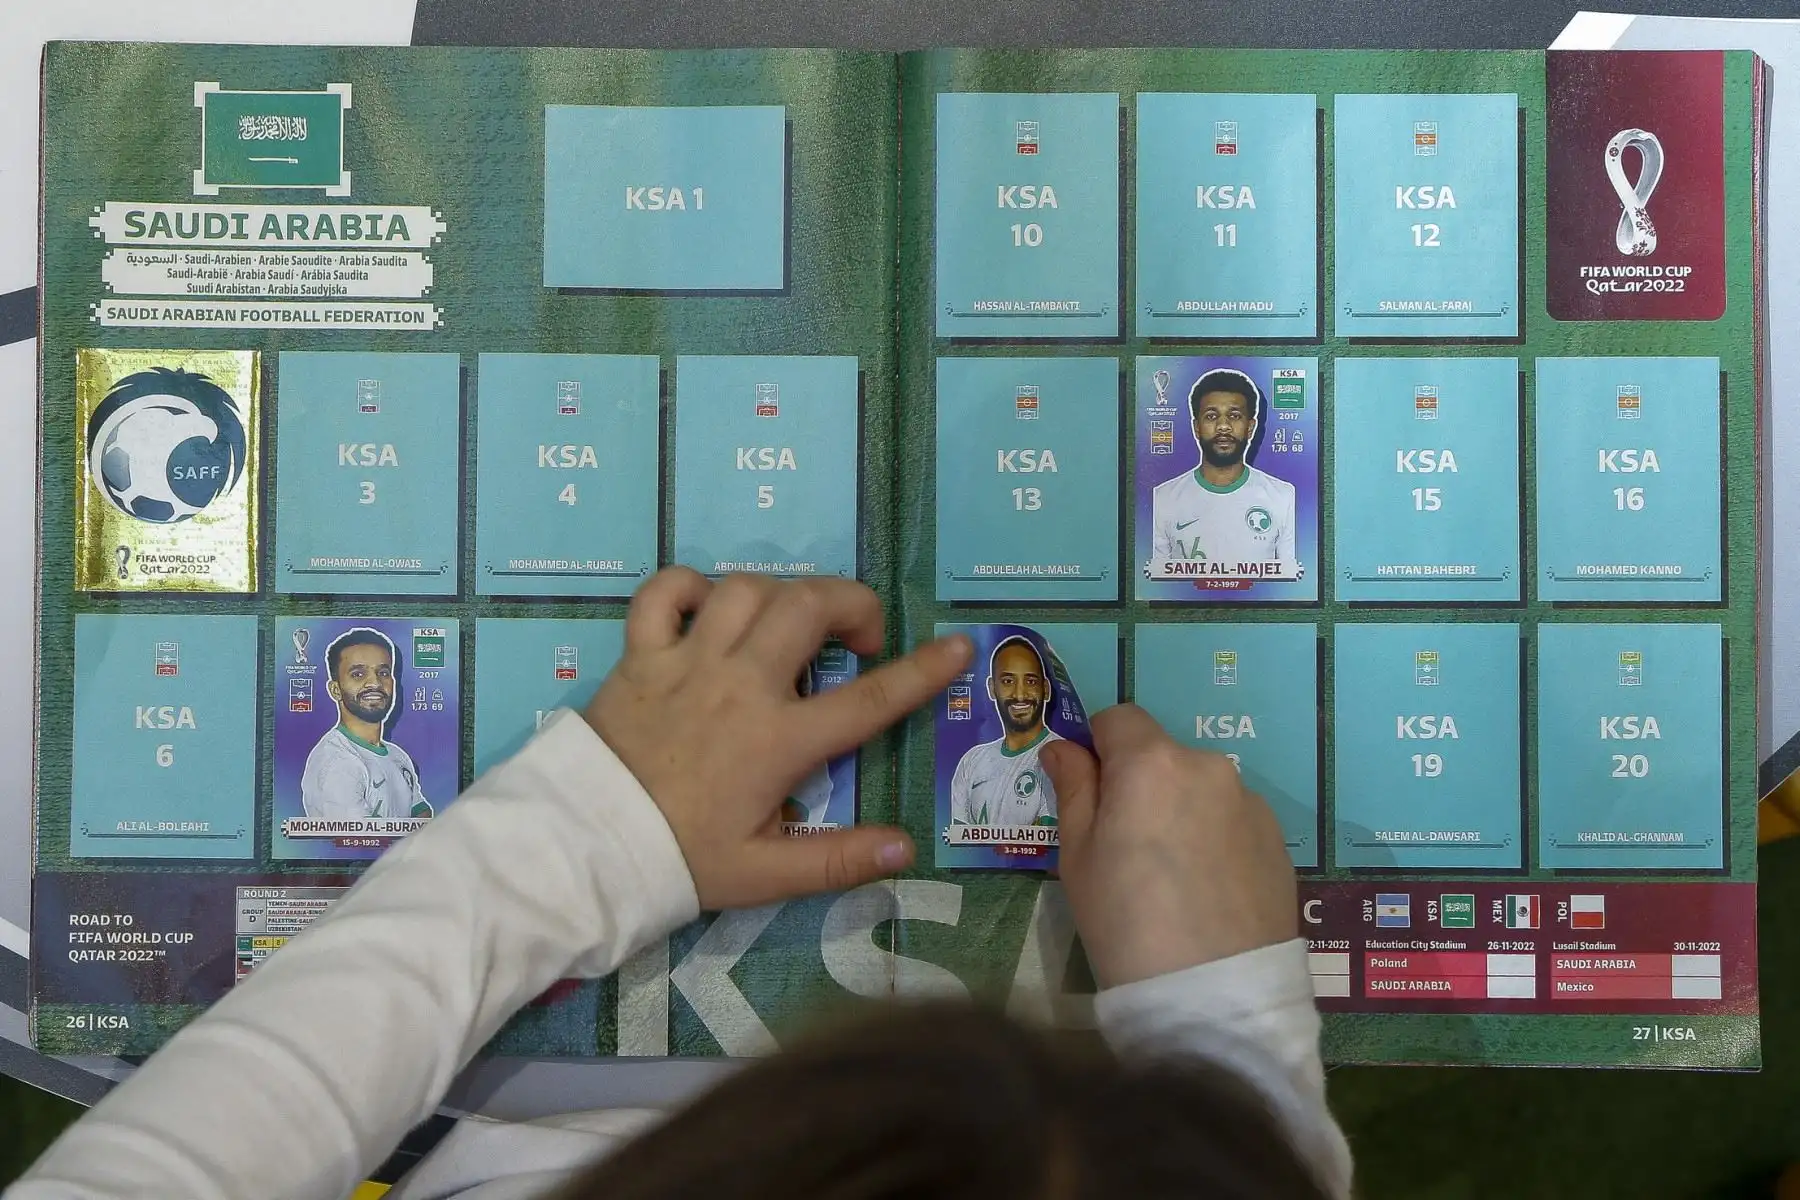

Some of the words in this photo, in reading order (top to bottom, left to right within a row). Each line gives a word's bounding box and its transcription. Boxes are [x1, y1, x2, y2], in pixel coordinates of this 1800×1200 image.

[625, 186, 686, 211] KSA
[693, 186, 703, 210] 1
[998, 185, 1058, 209] KSA
[1196, 185, 1257, 209] KSA
[1395, 185, 1456, 209] KSA
[124, 210, 249, 240] SAUDI
[259, 213, 411, 242] ARABIA
[1010, 223, 1043, 247] 10
[1214, 223, 1237, 247] 11
[1410, 224, 1441, 247] 12
[126, 252, 177, 266] السعودية
[184, 254, 251, 266] Saudi-Arabien
[258, 254, 290, 266] Arabie
[292, 255, 332, 266] Saoudite
[339, 255, 370, 266] Arabia
[372, 256, 408, 267] Saudita
[167, 268, 228, 280] Saudi-Arabië
[235, 269, 266, 280] Arabia
[268, 269, 294, 280] Saudí
[301, 269, 331, 280] Arábia
[334, 270, 369, 280] Saudita
[1580, 266, 1611, 278] FIFA
[1612, 266, 1662, 278] WORLD
[1665, 266, 1692, 278] CUP
[187, 282, 214, 294] Suudi
[216, 284, 261, 294] Arabistan
[268, 284, 298, 295] Arabia
[300, 284, 348, 296] Saudyjska
[974, 301, 1012, 310] HASSAN
[1014, 301, 1080, 311] AL-TAMBAKTI
[1176, 301, 1236, 311] ABDULLAH
[1239, 301, 1273, 311] MADU
[1379, 302, 1423, 311] SALMAN
[1424, 302, 1472, 312] AL-FARAJ
[107, 307, 159, 320] SAUDI
[162, 308, 236, 322] ARABIAN
[240, 310, 320, 322] FOOTBALL
[324, 310, 424, 324] FEDERATION
[1280, 412, 1299, 420] 2017
[338, 443, 399, 467] KSA
[1292, 444, 1304, 452] 68
[538, 445, 599, 469] KSA
[736, 447, 798, 471] KSA
[997, 449, 1058, 473] KSA
[1396, 450, 1458, 474] KSA
[1598, 449, 1660, 473] KSA
[174, 466, 220, 480] SAFF
[358, 481, 376, 504] 3
[558, 483, 577, 506] 4
[757, 485, 775, 508] 5
[1012, 488, 1042, 511] 13
[1412, 488, 1442, 511] 15
[1612, 488, 1645, 511] 16
[136, 555, 158, 564] FIFA
[160, 555, 194, 564] WORLD
[196, 555, 216, 563] CUP
[310, 557, 372, 568] MOHAMMED
[374, 558, 422, 570] AL-OWAIS
[509, 560, 568, 570] MOHAMMED
[570, 560, 624, 570] AL-RUBAIE
[714, 562, 770, 572] ABDULELAH
[772, 562, 816, 572] AL-AMRI
[973, 564, 1030, 574] ABDULELAH
[1032, 565, 1080, 574] AL-MALKI
[1164, 562, 1206, 575] SAMI
[1210, 562, 1282, 578] AL-NAJEI
[1378, 565, 1422, 575] HATTAN
[1424, 565, 1476, 575] BAHEBRI
[1576, 565, 1638, 575] MOHAMED
[1640, 565, 1682, 575] KANNO
[432, 703, 443, 711] 69
[135, 706, 196, 730] KSA
[1196, 716, 1256, 738] KSA
[1396, 716, 1460, 739] KSA
[1600, 716, 1662, 740] KSA
[155, 744, 174, 767] 6
[1411, 754, 1443, 778] 19
[1612, 754, 1648, 778] 20
[116, 821, 136, 832] ALI
[290, 822, 363, 832] MOHAMMED
[366, 822, 427, 832] AL-BURAY
[962, 828, 1034, 841] ABDULLAH
[1038, 830, 1059, 842] OTA
[1374, 831, 1410, 841] SALEM
[1412, 831, 1480, 842] AL-DAWSARI
[1578, 832, 1616, 842] KHALID
[1617, 832, 1684, 842] AL-GHANNAM
[244, 890, 278, 898] ROUND
[280, 890, 287, 898] 2
[1304, 900, 1322, 924] C
[1362, 899, 1372, 922] ARG
[1427, 900, 1437, 921] KSA
[1492, 900, 1502, 923] MEX
[1558, 901, 1567, 922] POL
[69, 914, 110, 926] ROAD
[114, 914, 133, 926] TO
[68, 932, 102, 943] FIFA
[107, 932, 162, 944] WORLD
[165, 933, 194, 944] CUP
[1366, 940, 1409, 949] Education
[1411, 940, 1428, 951] City
[1429, 940, 1466, 949] Stadium
[1487, 942, 1535, 950] 26-11-2022
[1553, 942, 1579, 951] Lusail
[1580, 942, 1616, 951] Stadium
[1673, 942, 1720, 951] 30-11-2022
[68, 950, 117, 962] QATAR
[1371, 958, 1408, 968] Poland
[1556, 959, 1592, 969] SAUDI
[1594, 960, 1636, 969] ARABIA
[1371, 981, 1406, 990] SAUDI
[1408, 981, 1451, 990] ARABIA
[1557, 982, 1594, 991] Mexico
[66, 1016, 86, 1028] 26
[98, 1016, 130, 1029] KSA
[1632, 1028, 1650, 1040] 27
[1663, 1028, 1696, 1040] KSA
